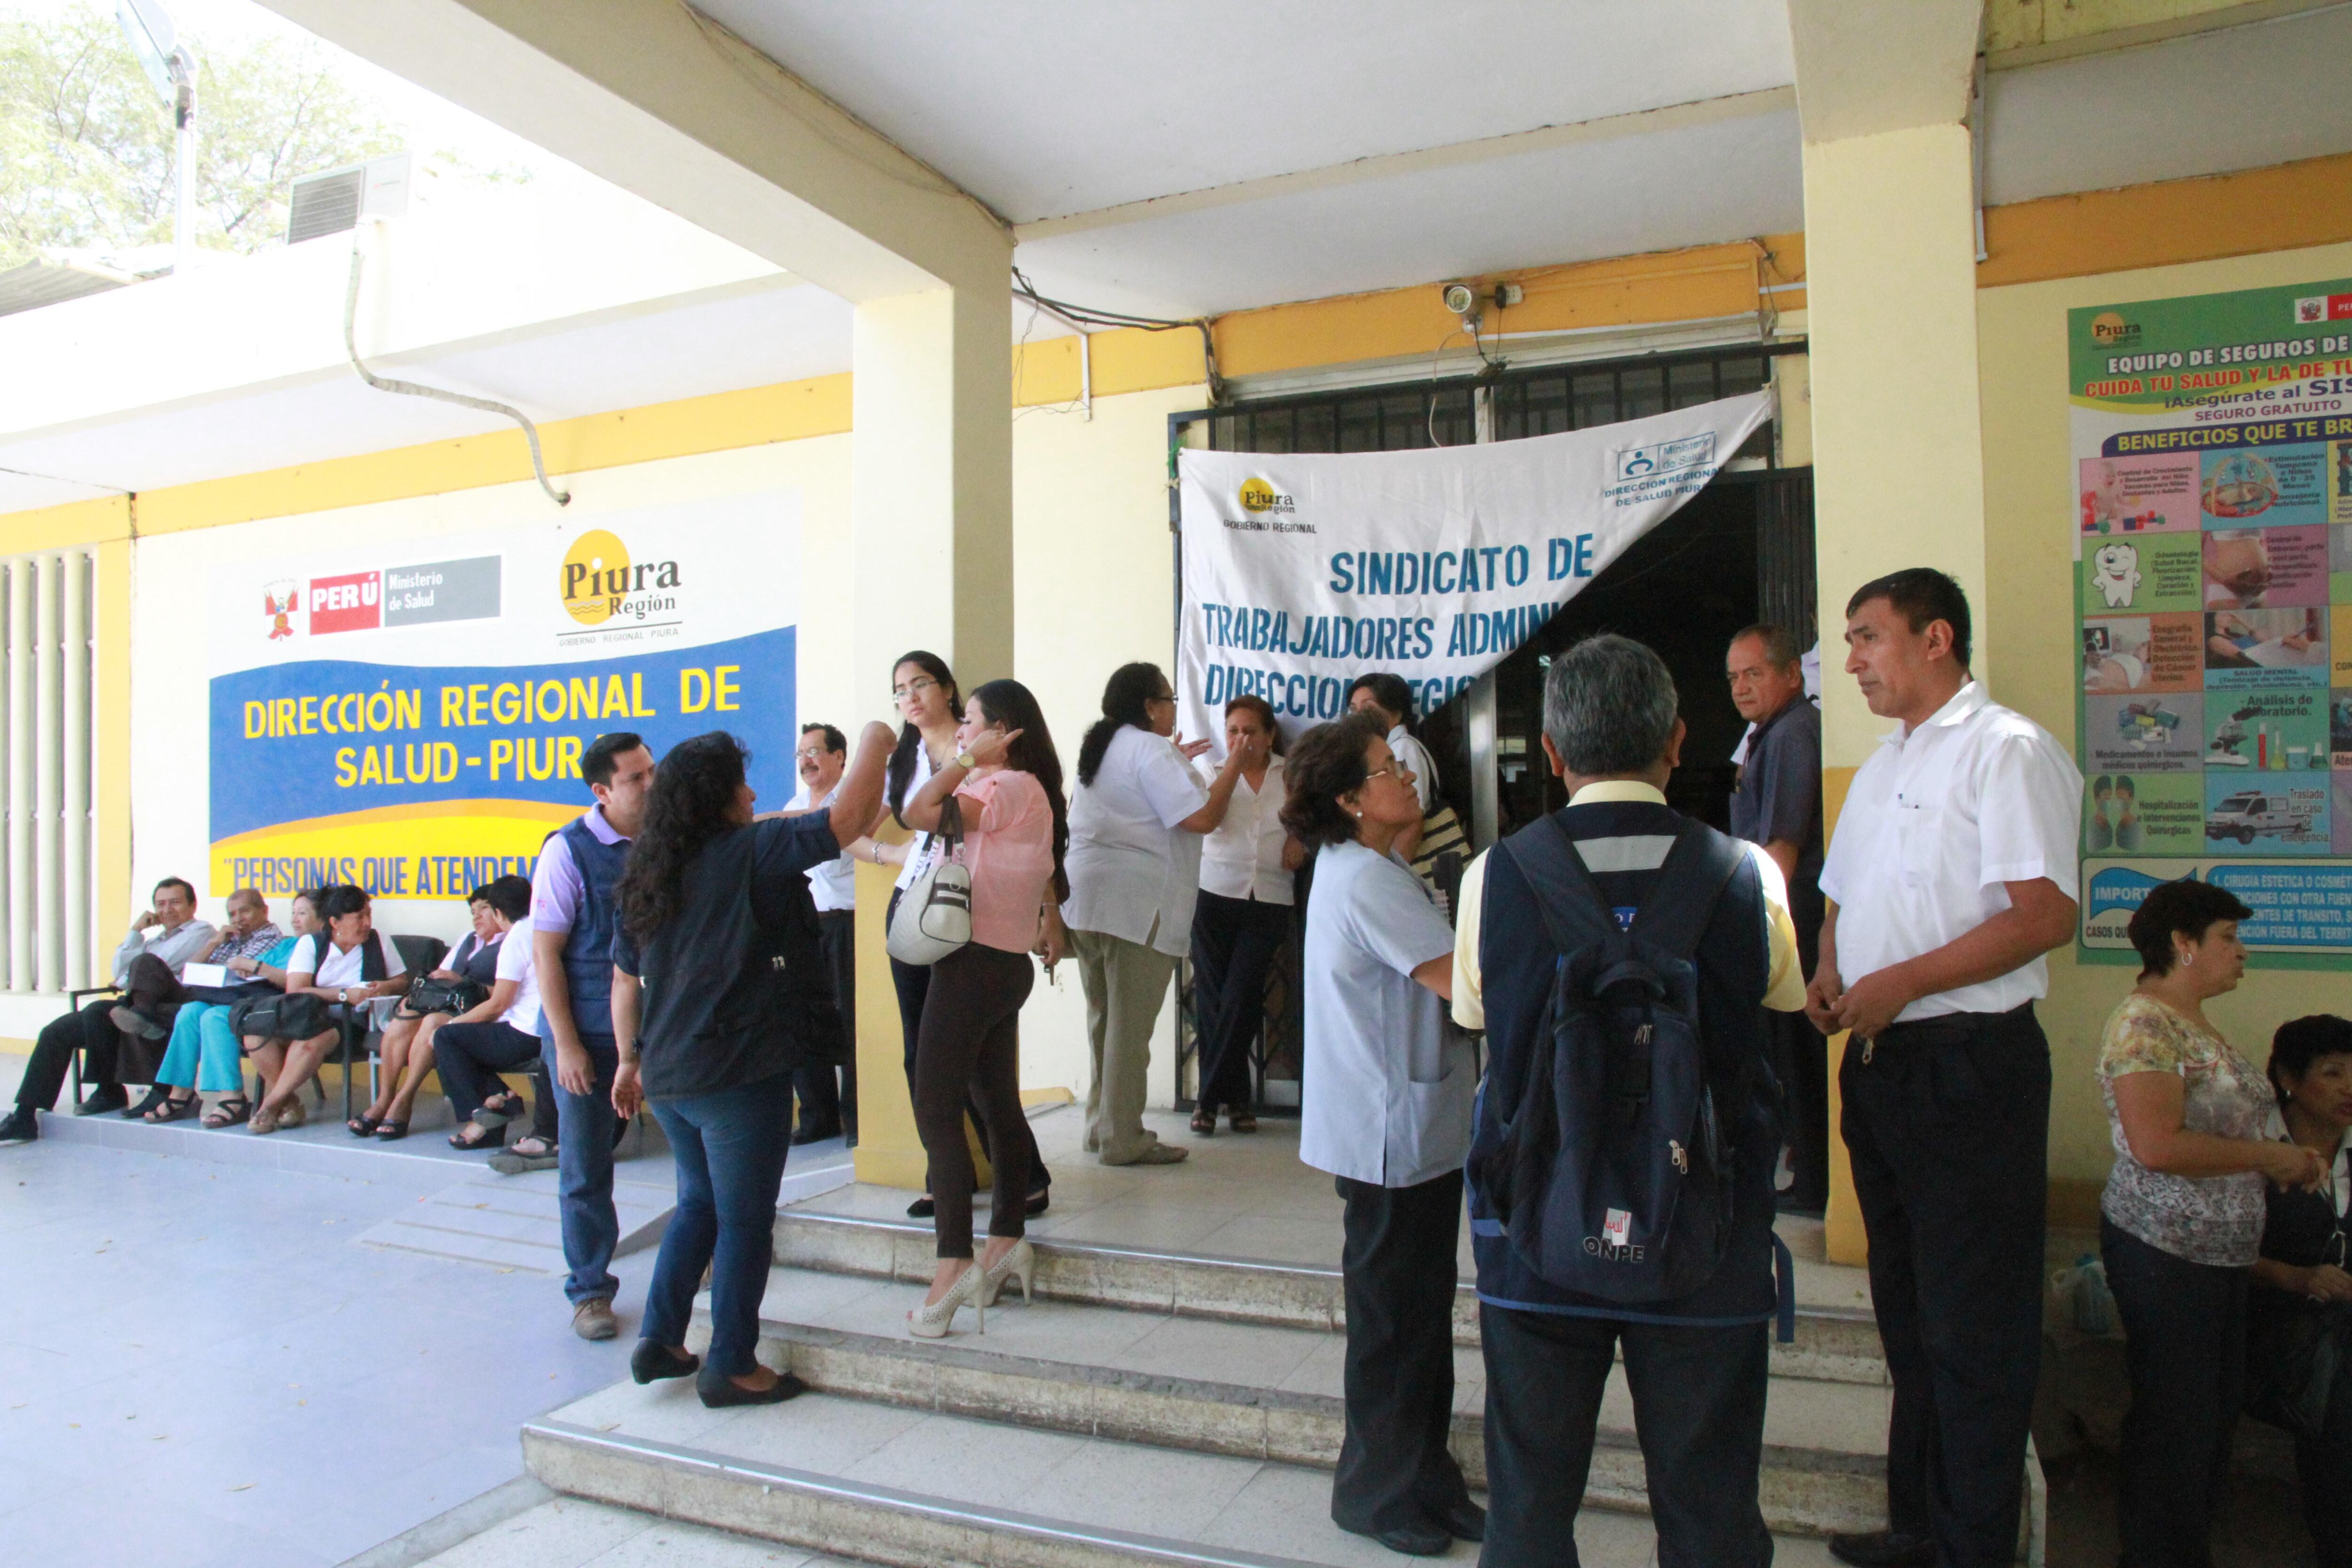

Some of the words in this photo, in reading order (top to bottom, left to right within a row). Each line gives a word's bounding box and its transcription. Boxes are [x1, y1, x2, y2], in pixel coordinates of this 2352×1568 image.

[2338, 303, 2352, 311] PE
[2095, 324, 2140, 337] Piura
[2108, 352, 2183, 374] EQUIPO
[2189, 349, 2213, 366] DE
[2220, 339, 2315, 363] SEGUROS
[2322, 335, 2348, 353] DE
[2085, 379, 2143, 398] CUIDA
[2149, 376, 2173, 392] TU
[2180, 370, 2241, 390] SALUD
[2248, 367, 2260, 383] Y
[2267, 365, 2292, 382] LA
[2298, 362, 2325, 379] DE
[2282, 385, 2301, 398] al
[2194, 406, 2256, 422] SEGURO
[2260, 399, 2342, 416] GRATUITO
[2118, 427, 2239, 451] BENEFICIOS
[2244, 423, 2287, 445] QUE
[2291, 420, 2318, 438] TE
[1663, 437, 1712, 455] Ministerio
[1662, 459, 1676, 470] de
[1678, 451, 1707, 466] Salud
[1604, 478, 1667, 498] DIRECCIÓN
[1615, 495, 1631, 507] DE
[1635, 490, 1673, 503] SALUD
[1675, 482, 1706, 495] PIUR
[1245, 491, 1294, 505] Piura
[1261, 503, 1295, 515] Región
[1223, 519, 1269, 531] GOBIERNO
[1272, 522, 1317, 534] REGIONAL
[1330, 544, 1530, 595] SINDICATO
[1547, 532, 1593, 581] DE
[389, 571, 443, 590] Ministerio
[564, 559, 682, 600] Piura
[311, 573, 378, 612] PERÚ
[389, 596, 402, 611] de
[404, 589, 434, 609] Salud
[608, 593, 676, 620] Región
[559, 636, 596, 647] GOBIERNO
[603, 631, 644, 642] REGIONAL
[651, 628, 679, 637] PIURA
[1201, 602, 1435, 660] TRABAJADORES
[244, 679, 421, 740] DIRECCIÓN
[441, 672, 656, 727] REGIONAL
[680, 664, 740, 714] DE
[2247, 694, 2295, 705] Análisis
[2298, 694, 2312, 705] de
[2095, 750, 2155, 759] Medicamentos
[2335, 755, 2352, 766] Ate
[2289, 788, 2324, 799] Traslado
[2138, 800, 2199, 811] Hospitalización
[2302, 817, 2312, 828] de
[2280, 834, 2330, 844] emergencia.
[363, 856, 408, 897] QUE
[2280, 892, 2299, 905] CON
[2301, 892, 2325, 905] OTRA
[2282, 909, 2295, 922] DE
[2086, 925, 2113, 938] CASOS
[2270, 925, 2298, 938] FUERA
[2301, 926, 2318, 939] DEL
[1583, 1236, 1645, 1263] ONPE
